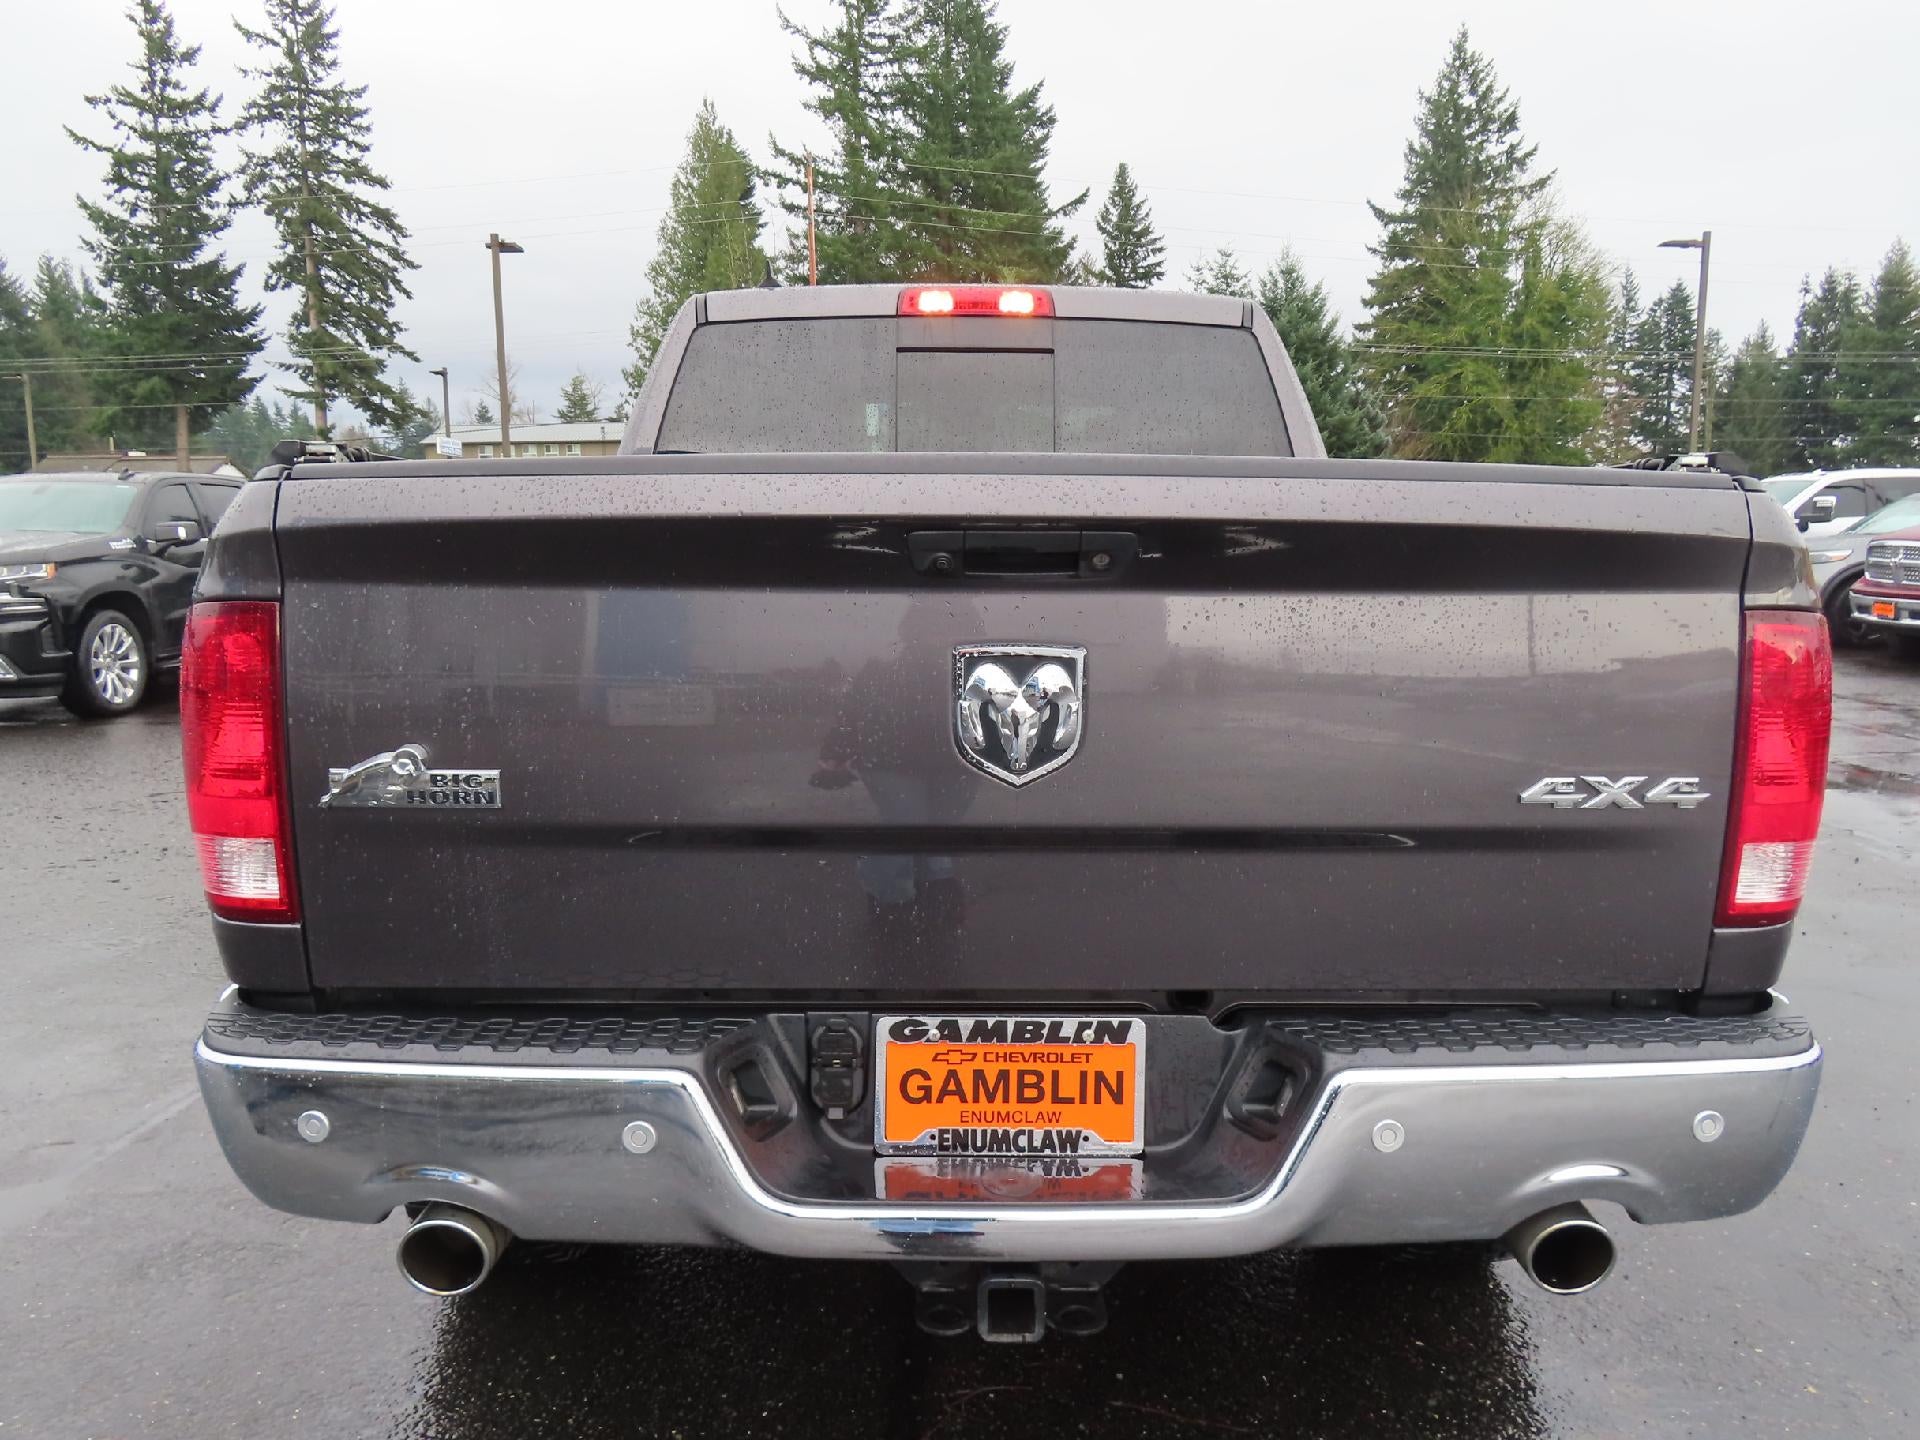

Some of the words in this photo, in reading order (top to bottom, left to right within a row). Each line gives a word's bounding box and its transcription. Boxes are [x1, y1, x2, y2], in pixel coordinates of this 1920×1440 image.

[430, 774, 483, 788] BIG
[406, 790, 495, 805] HORN
[888, 1019, 1132, 1044] GAMBLIN
[983, 1052, 1093, 1064] CHEVROLET
[899, 1068, 1124, 1105] GAMBLIN
[960, 1111, 1062, 1124] ENUMCLAW
[937, 1129, 1082, 1153] ENUMCLAW
